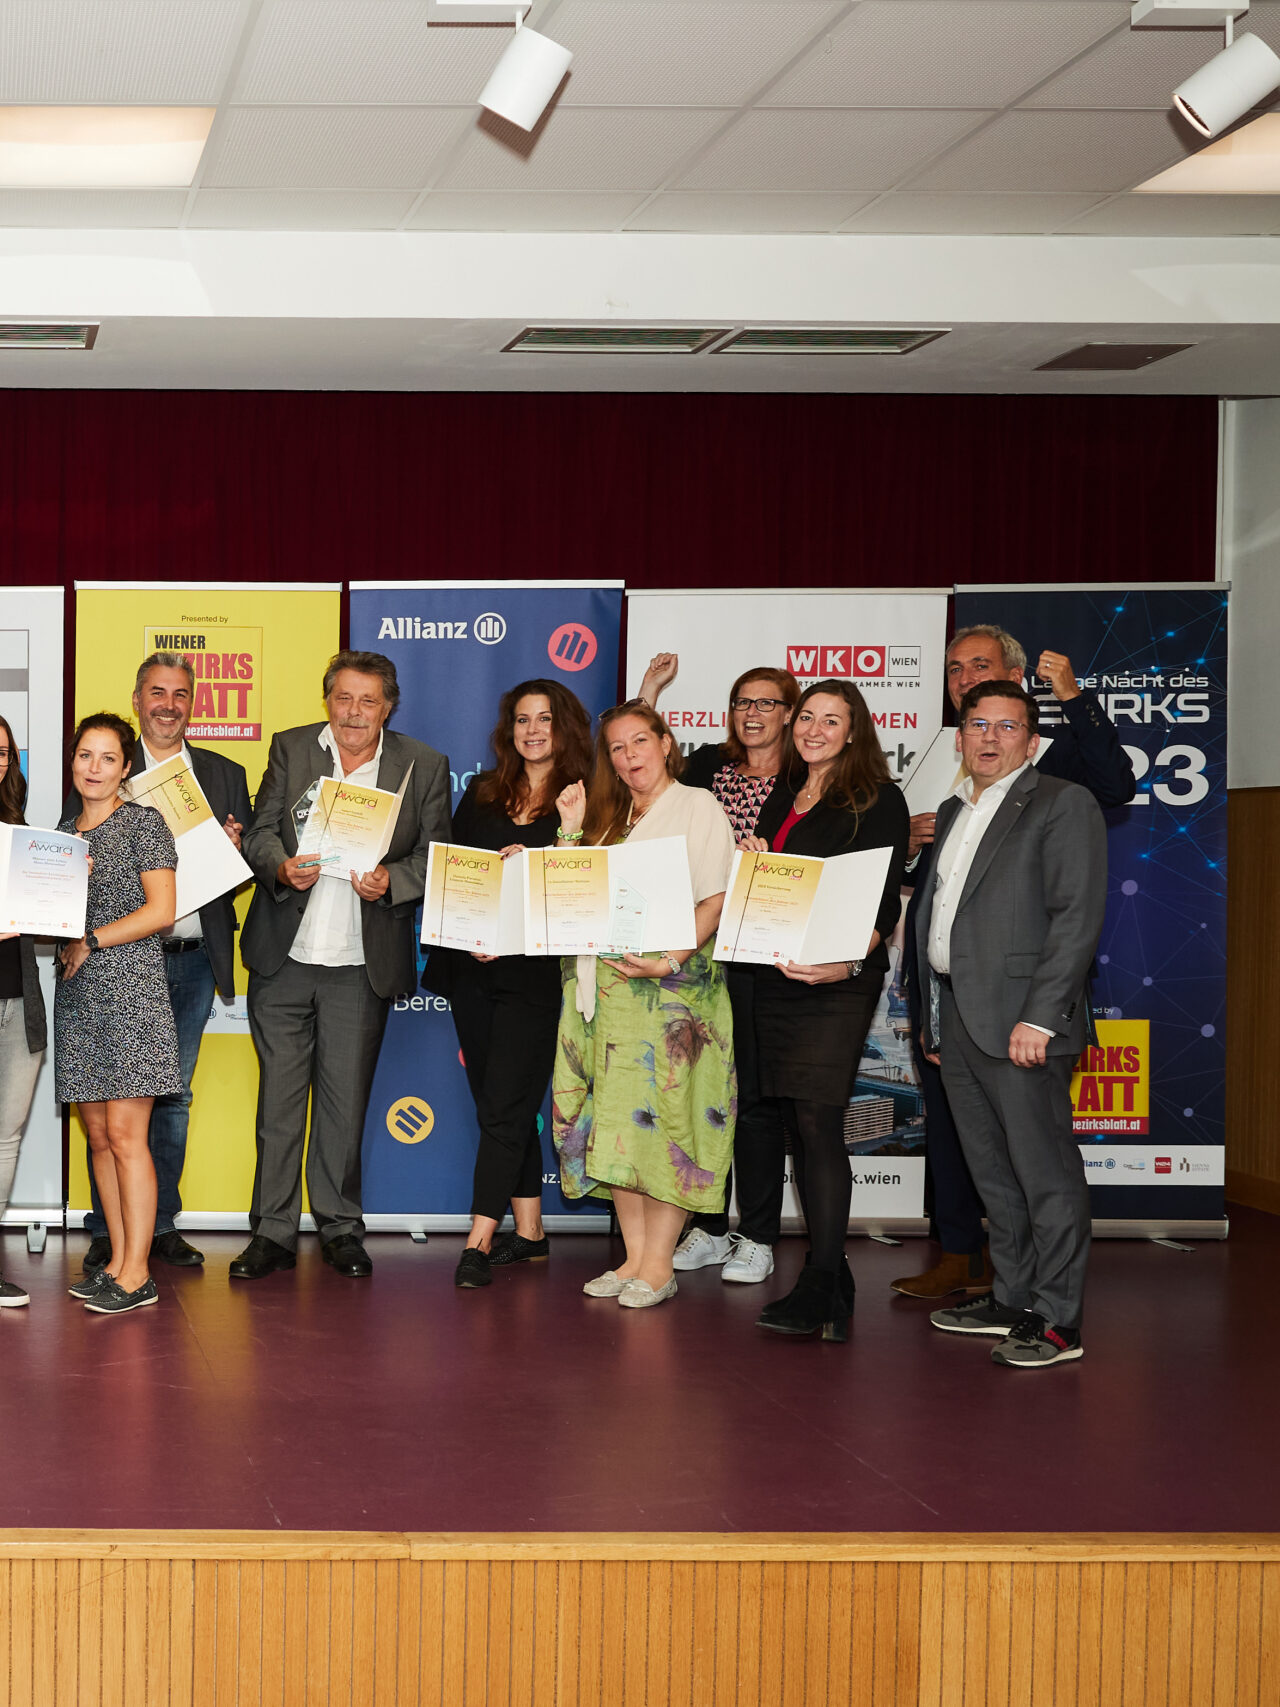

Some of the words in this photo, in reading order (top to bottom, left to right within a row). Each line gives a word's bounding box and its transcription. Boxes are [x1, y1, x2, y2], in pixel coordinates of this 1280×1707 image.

[181, 615, 218, 623] Presented
[219, 615, 229, 624] by
[378, 617, 468, 639] Allianz
[154, 634, 206, 649] WIENER
[789, 649, 882, 673] WKO
[891, 657, 918, 666] WIEN
[1031, 676, 1097, 690] Lage
[1102, 674, 1165, 688] Nacht
[1169, 674, 1209, 688] des
[192, 682, 253, 719] ATT
[1120, 744, 1210, 807] 23
[175, 775, 200, 813] Award
[336, 789, 379, 808] Award
[28, 839, 73, 855] Award
[448, 855, 490, 871] Award
[545, 858, 592, 870] Award
[755, 862, 805, 879] Award
[1072, 1076, 1140, 1112] ATT
